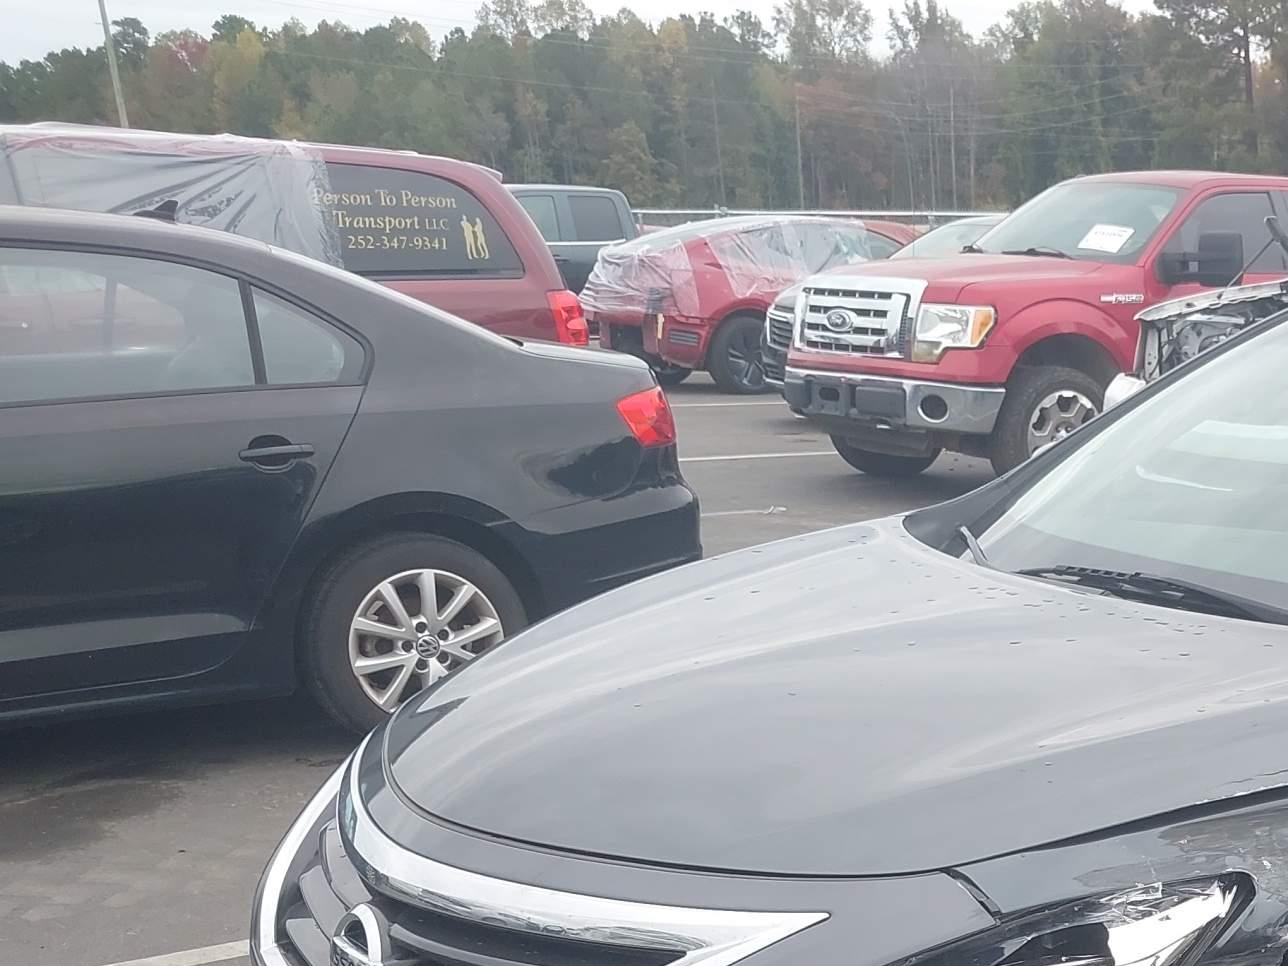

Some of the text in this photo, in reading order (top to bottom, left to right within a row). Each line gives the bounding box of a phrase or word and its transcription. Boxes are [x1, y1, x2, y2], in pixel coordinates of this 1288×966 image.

[313, 188, 457, 209] Person To Person
[332, 210, 449, 233] Transport LLC
[348, 235, 448, 250] 252-347-9341
